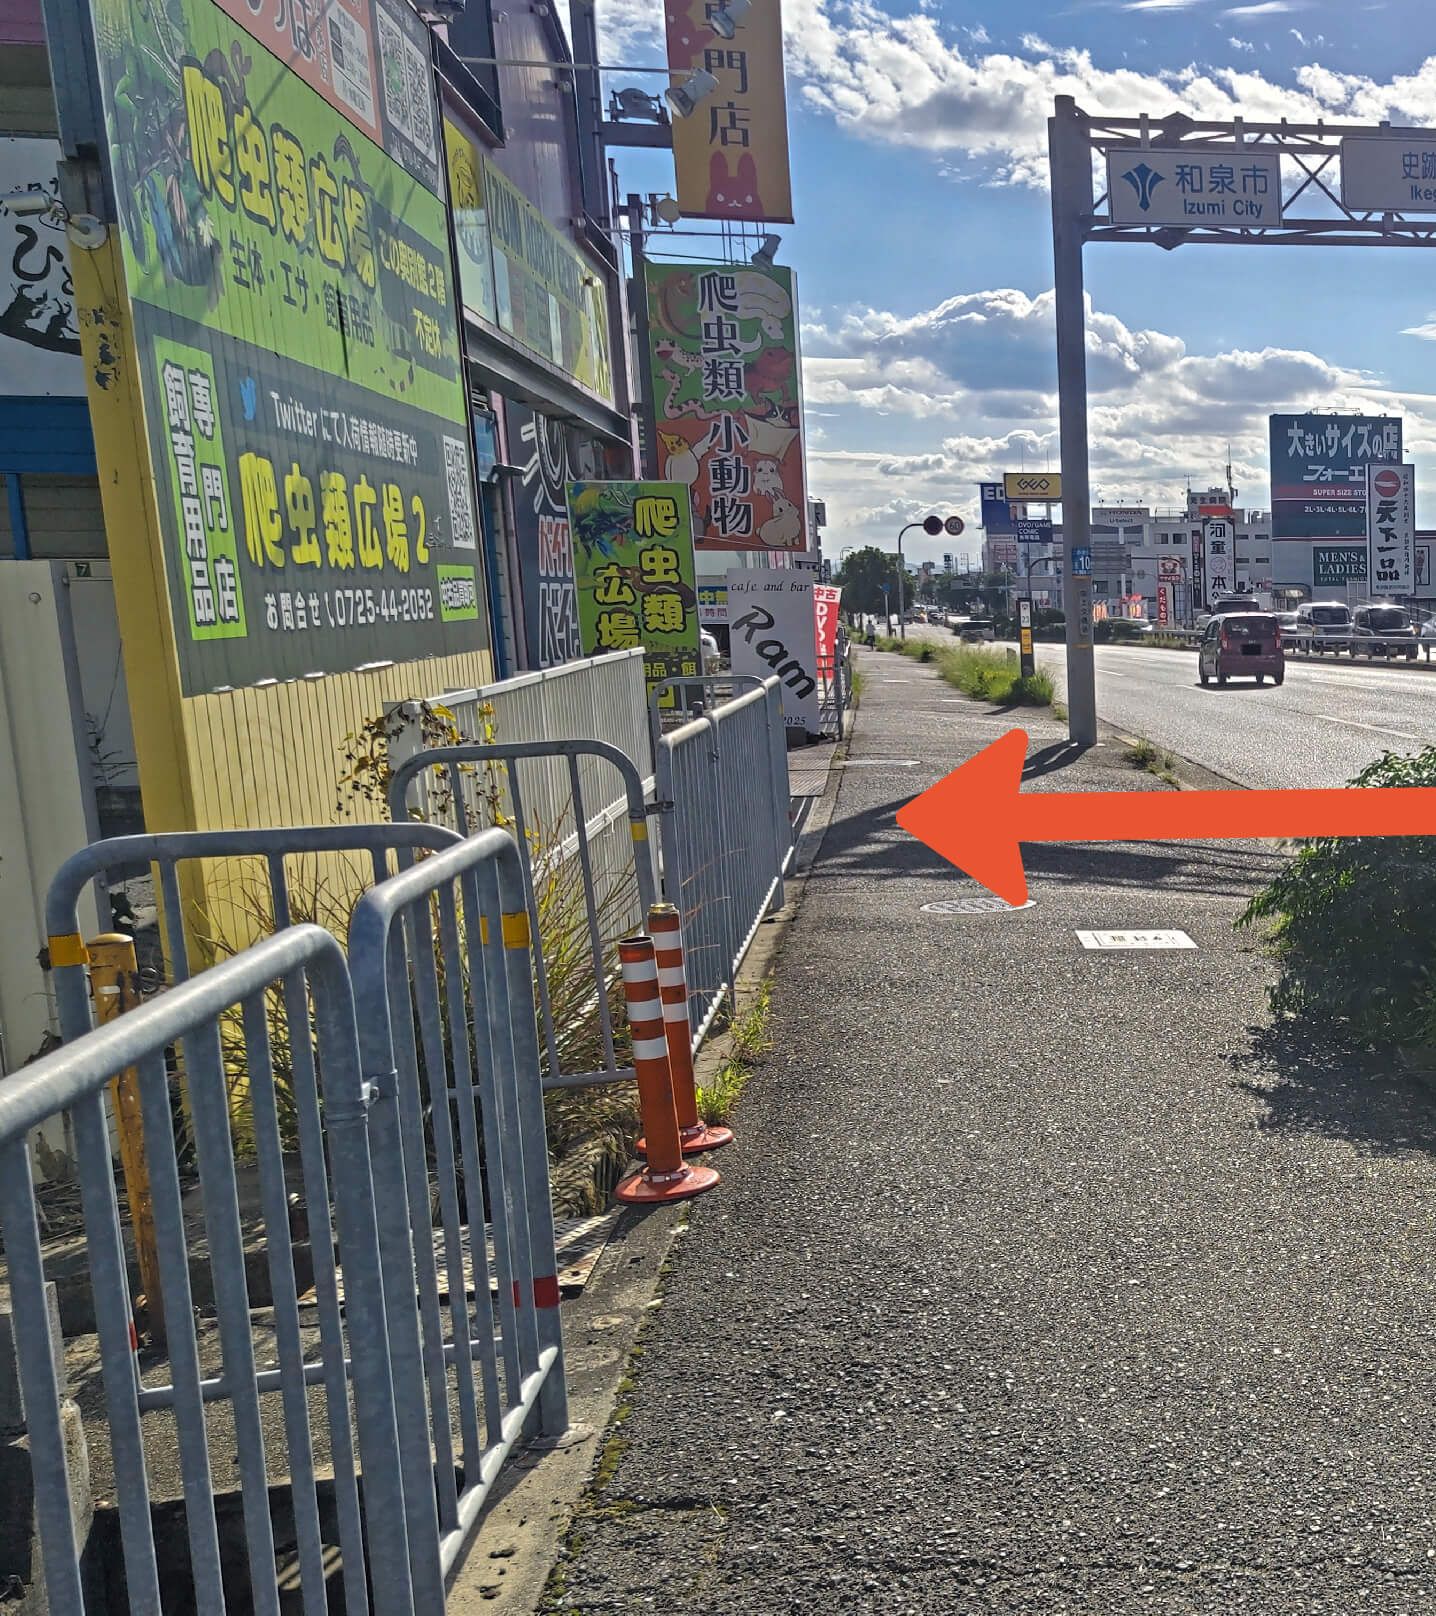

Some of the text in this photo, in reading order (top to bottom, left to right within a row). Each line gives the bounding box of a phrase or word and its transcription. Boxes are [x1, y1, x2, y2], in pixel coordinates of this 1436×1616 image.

[702, 0, 750, 148] 門店
[183, 63, 376, 292] 爬虫類広場
[1175, 164, 1269, 194] 和泉市
[1184, 199, 1263, 219] Izumi City
[270, 391, 318, 442] Twitter
[1287, 420, 1398, 460] 大きいサイズの店
[162, 360, 217, 626] 飼育用品
[188, 368, 241, 625] 専門店
[633, 496, 686, 633] 爬虫類
[1319, 551, 1358, 562] MEN'S
[1376, 500, 1400, 581] 天下一品
[731, 580, 810, 594] cafe and bar
[814, 587, 838, 600] 中古
[1319, 564, 1366, 574] LADIES
[265, 588, 434, 632] お問合せ 0725-44-2052
[594, 562, 640, 650] 広場
[731, 604, 816, 700] Ram
